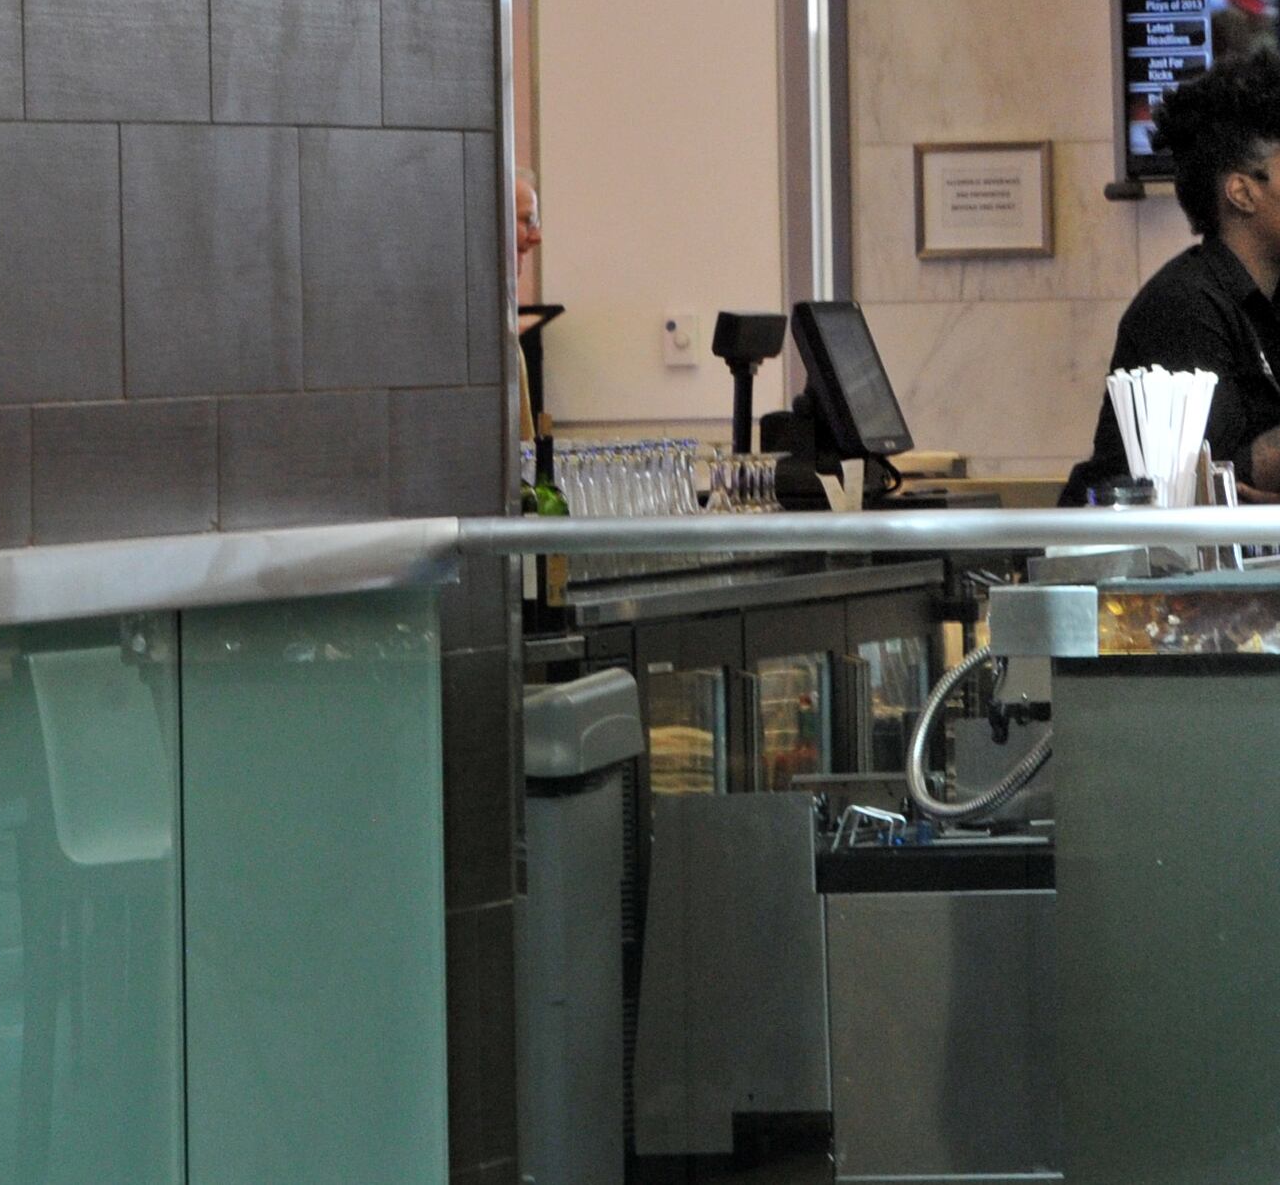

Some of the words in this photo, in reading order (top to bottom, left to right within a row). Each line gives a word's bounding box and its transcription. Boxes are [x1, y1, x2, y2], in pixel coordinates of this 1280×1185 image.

[1145, 0, 1169, 12] Plays
[1170, 0, 1180, 10] of
[1146, 22, 1175, 34] Latest
[1146, 35, 1191, 46] Headlines
[1148, 57, 1168, 69] Just
[1169, 57, 1184, 68] For
[1148, 70, 1174, 81] Kicks
